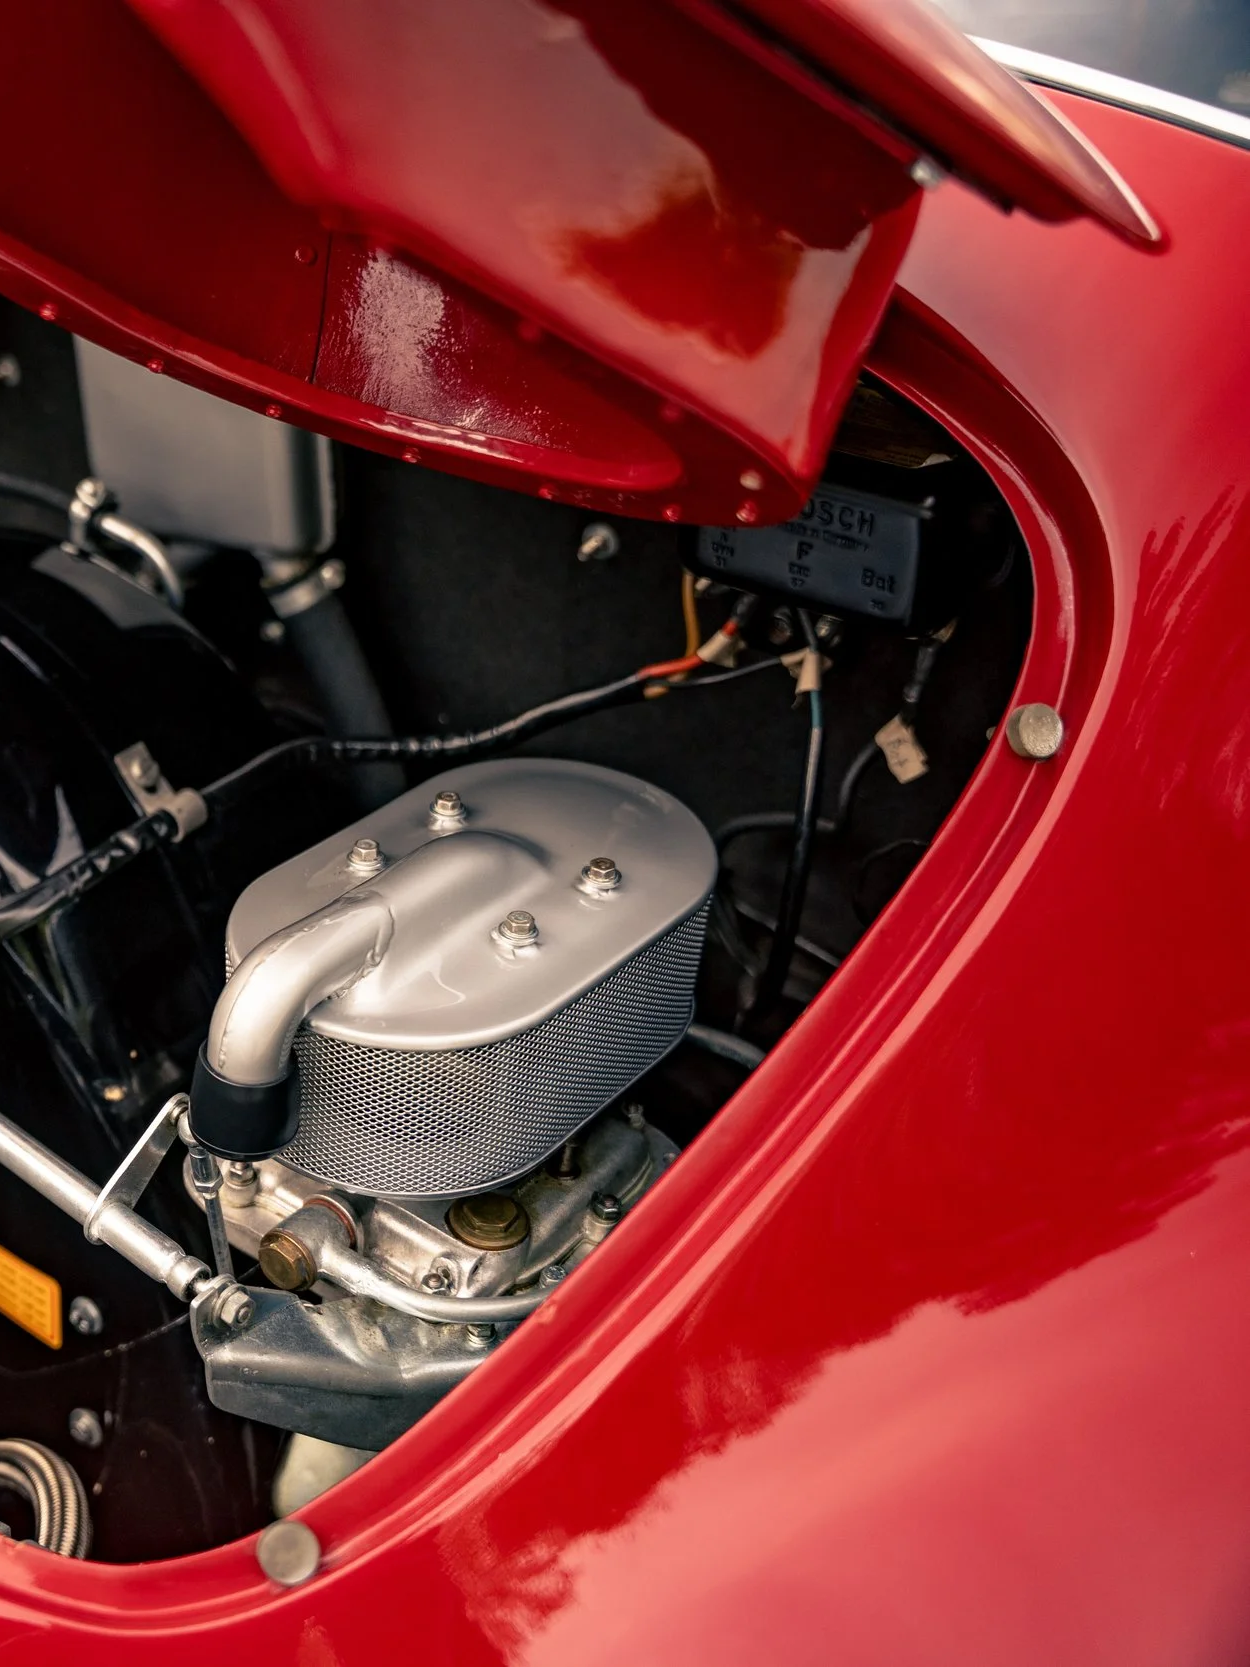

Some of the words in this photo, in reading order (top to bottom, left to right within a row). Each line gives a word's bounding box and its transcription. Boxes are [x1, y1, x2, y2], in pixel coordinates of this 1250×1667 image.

[800, 499, 875, 537] OSCH
[796, 541, 814, 560] F
[861, 567, 896, 594] Bat
